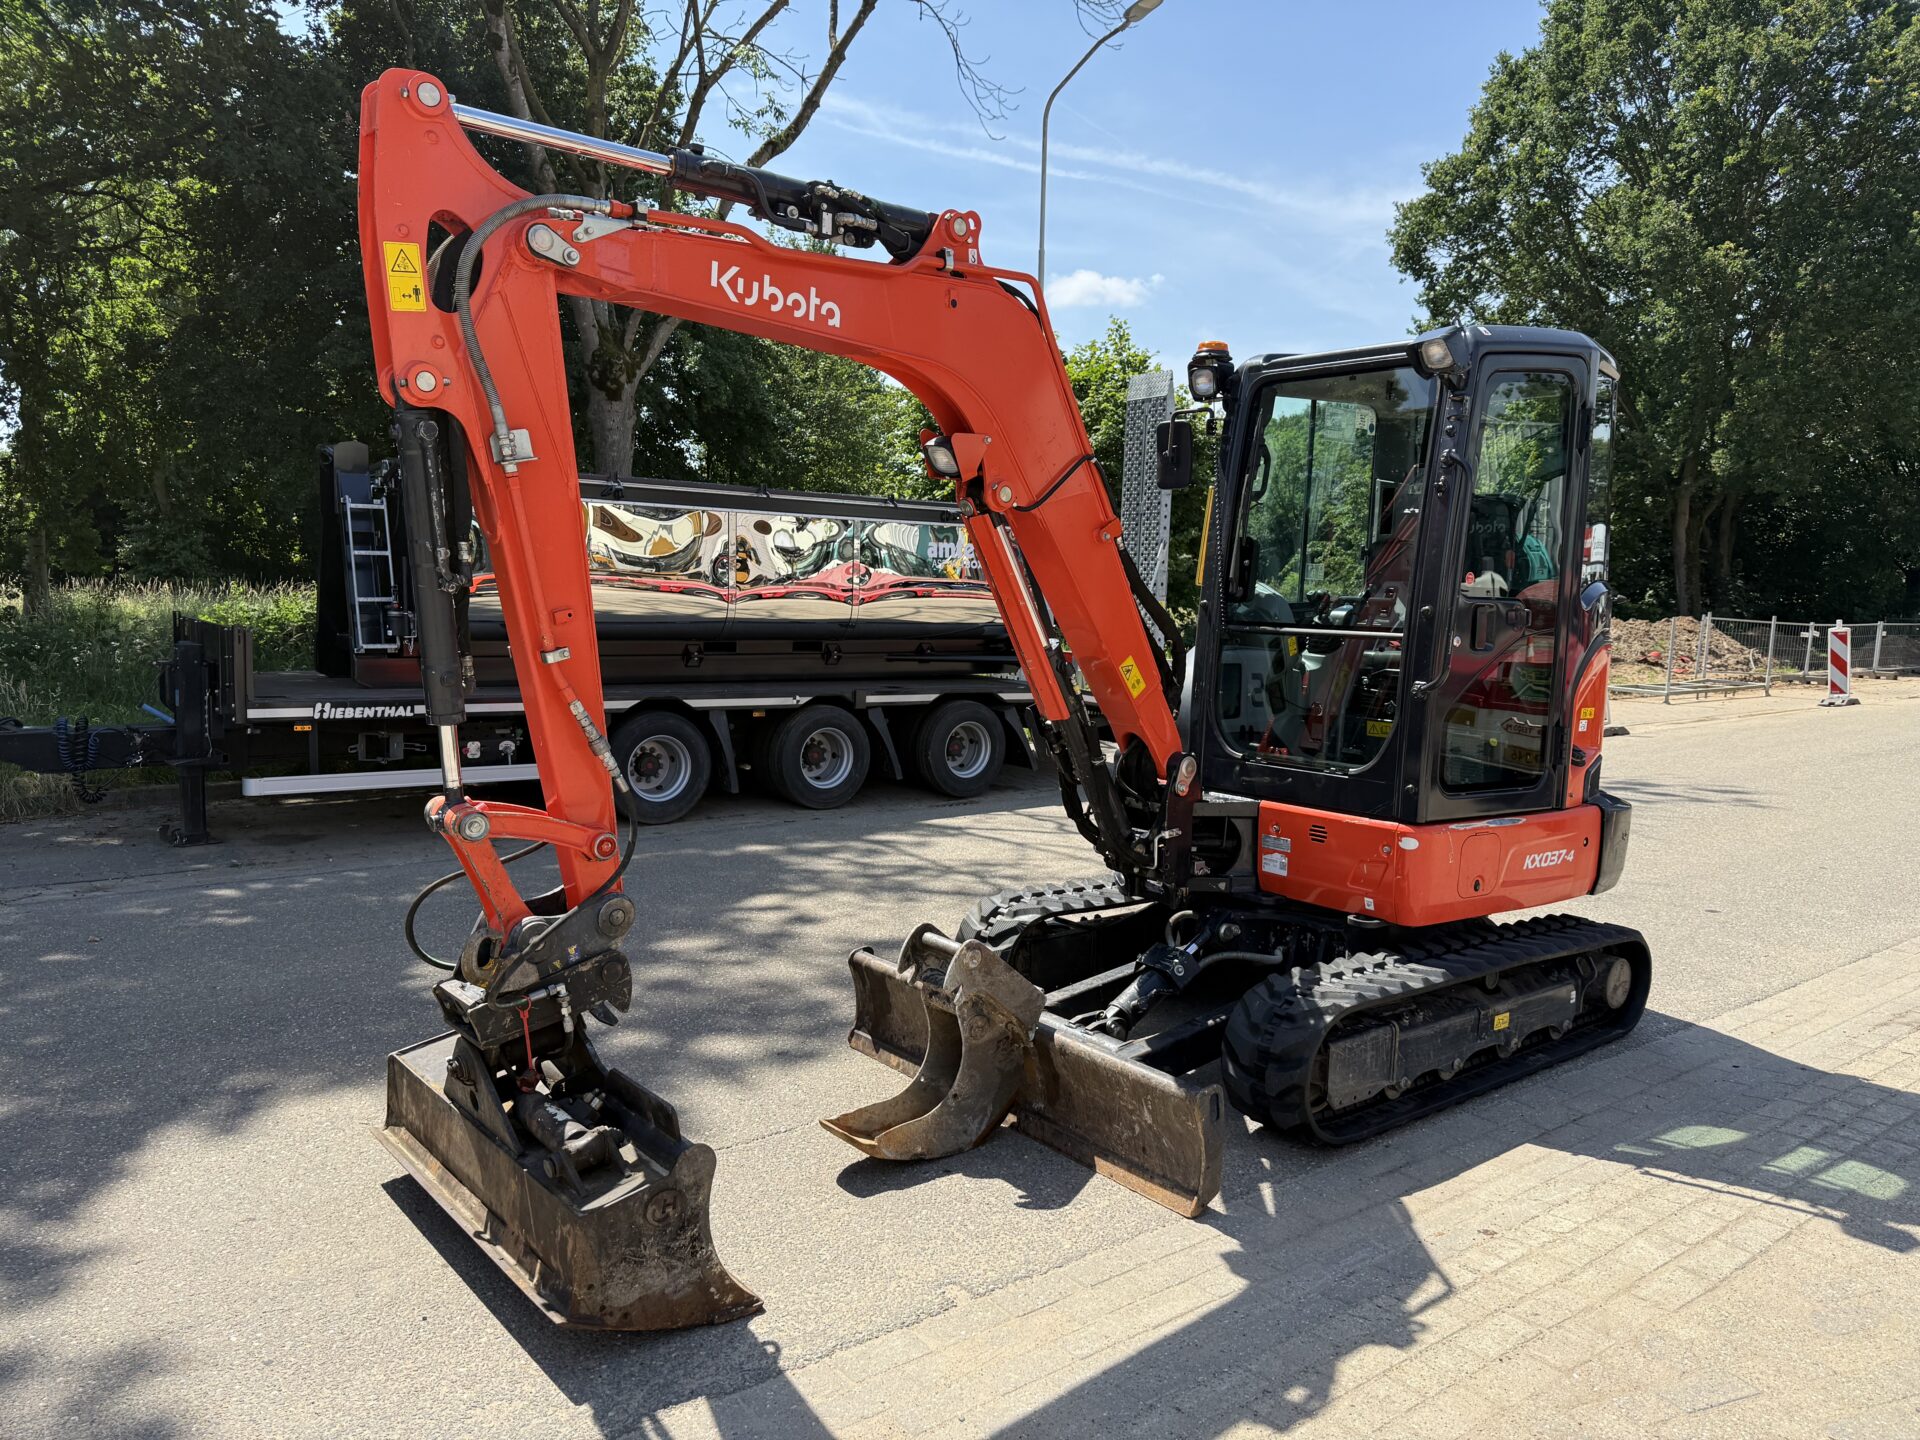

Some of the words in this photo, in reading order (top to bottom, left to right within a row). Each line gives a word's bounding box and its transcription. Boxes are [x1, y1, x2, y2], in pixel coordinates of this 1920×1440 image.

[710, 260, 841, 328] Kubota
[313, 702, 414, 719] HIEBENTHAL
[1523, 849, 1575, 870] KX037-4
